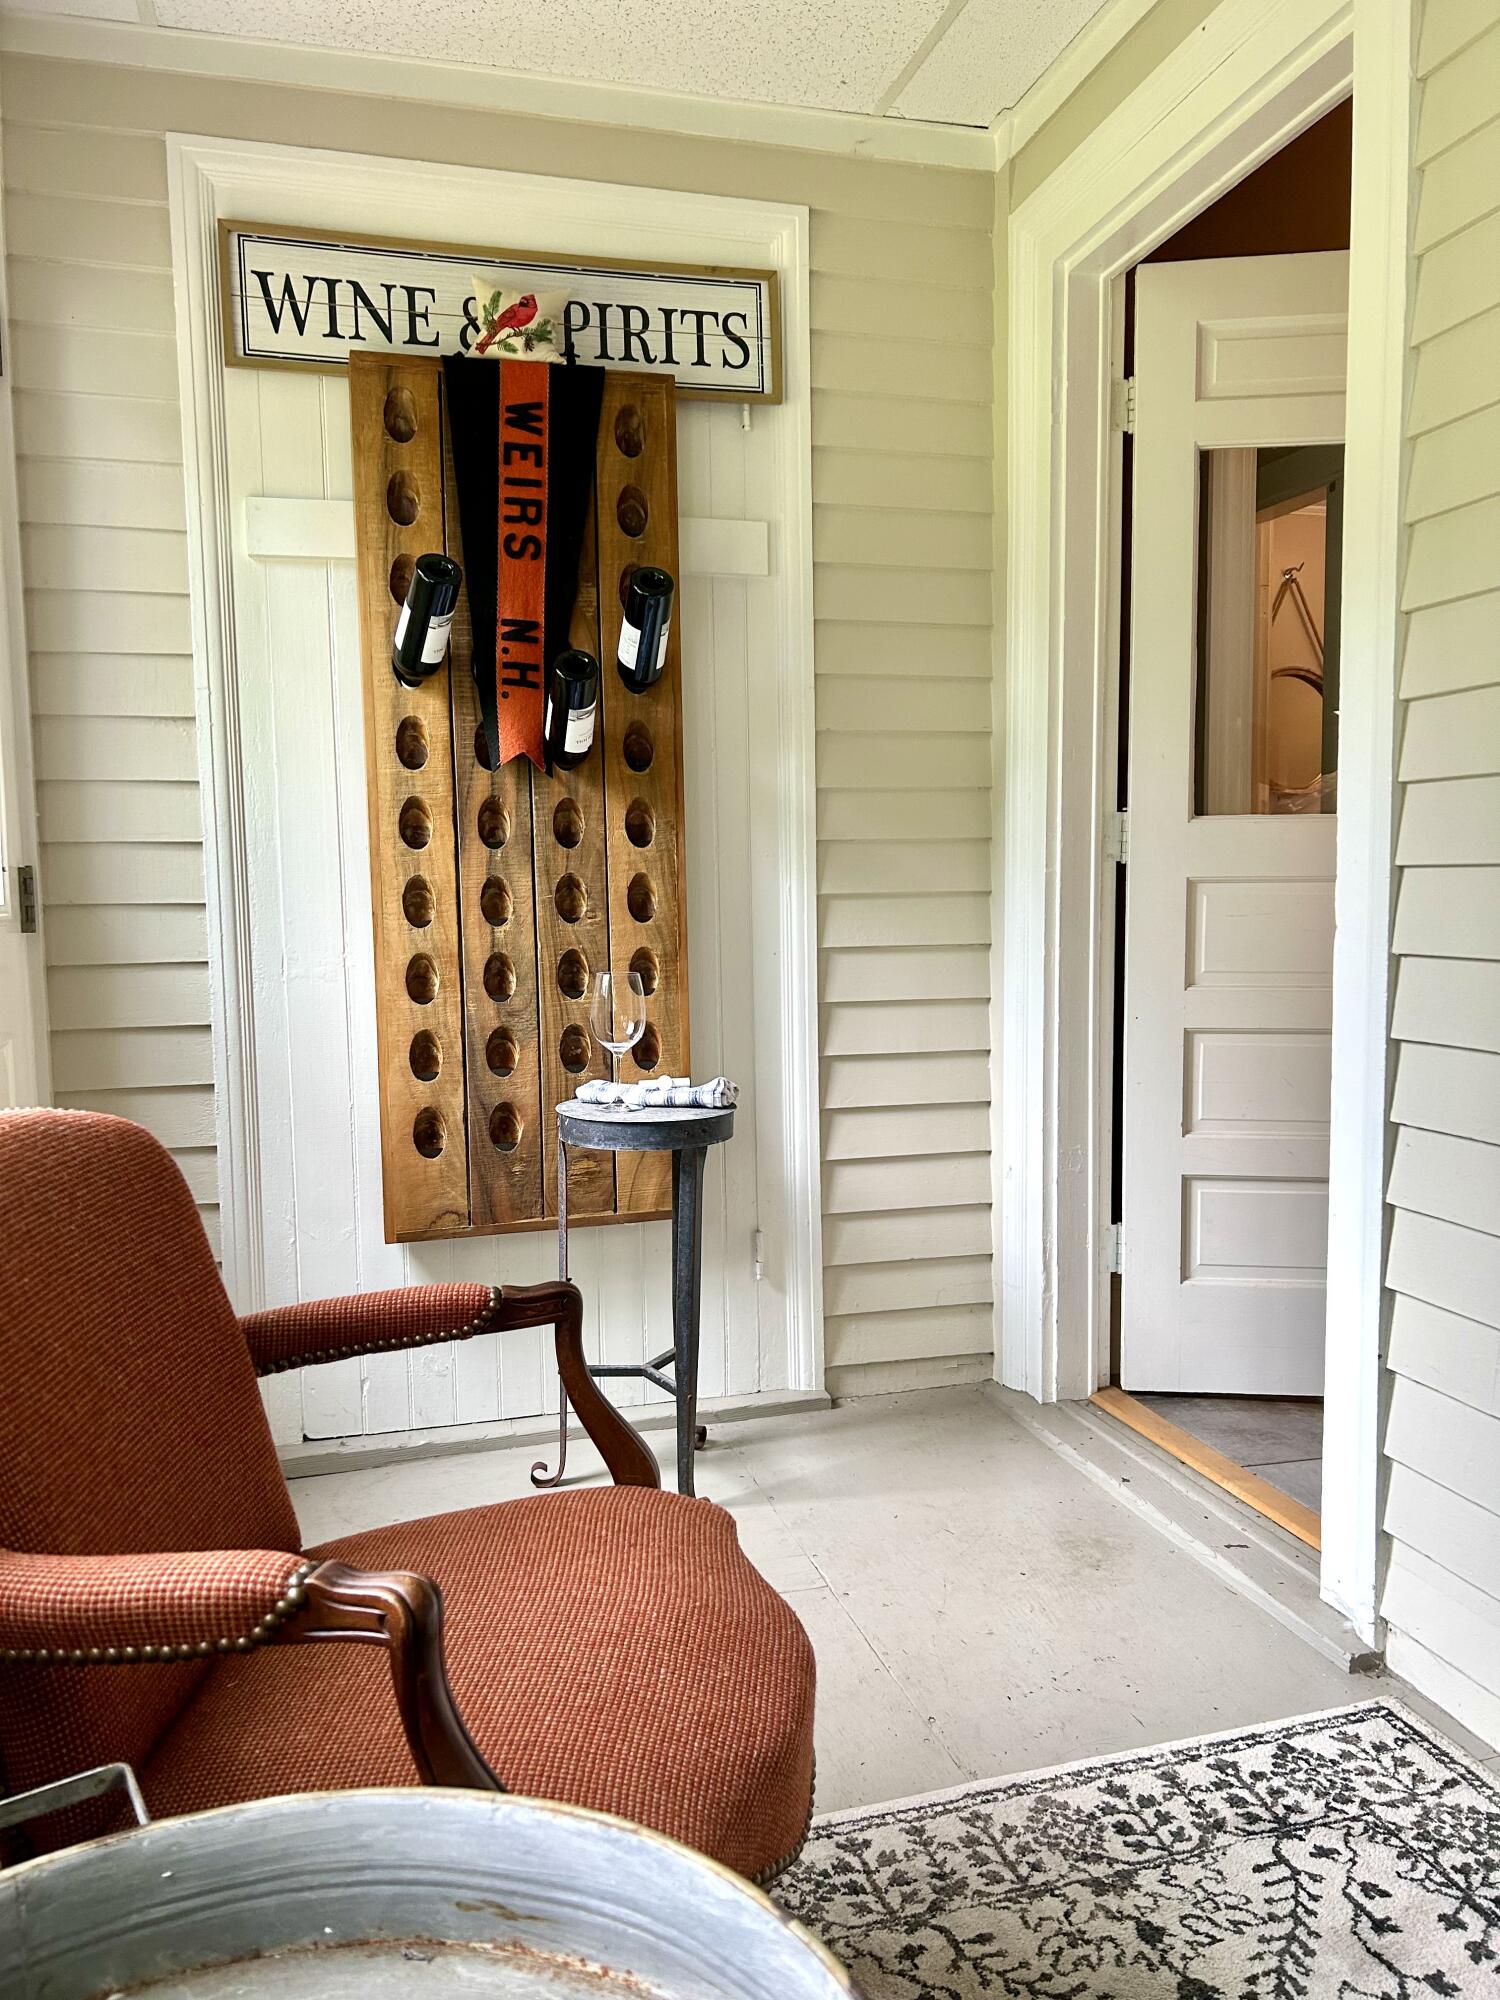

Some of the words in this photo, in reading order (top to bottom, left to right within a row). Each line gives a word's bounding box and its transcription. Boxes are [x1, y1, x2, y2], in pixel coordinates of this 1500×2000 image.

[251, 270, 440, 347] WINE
[559, 300, 750, 369] PIRITS
[503, 401, 544, 561] WEIRS
[501, 618, 540, 699] N.H.
